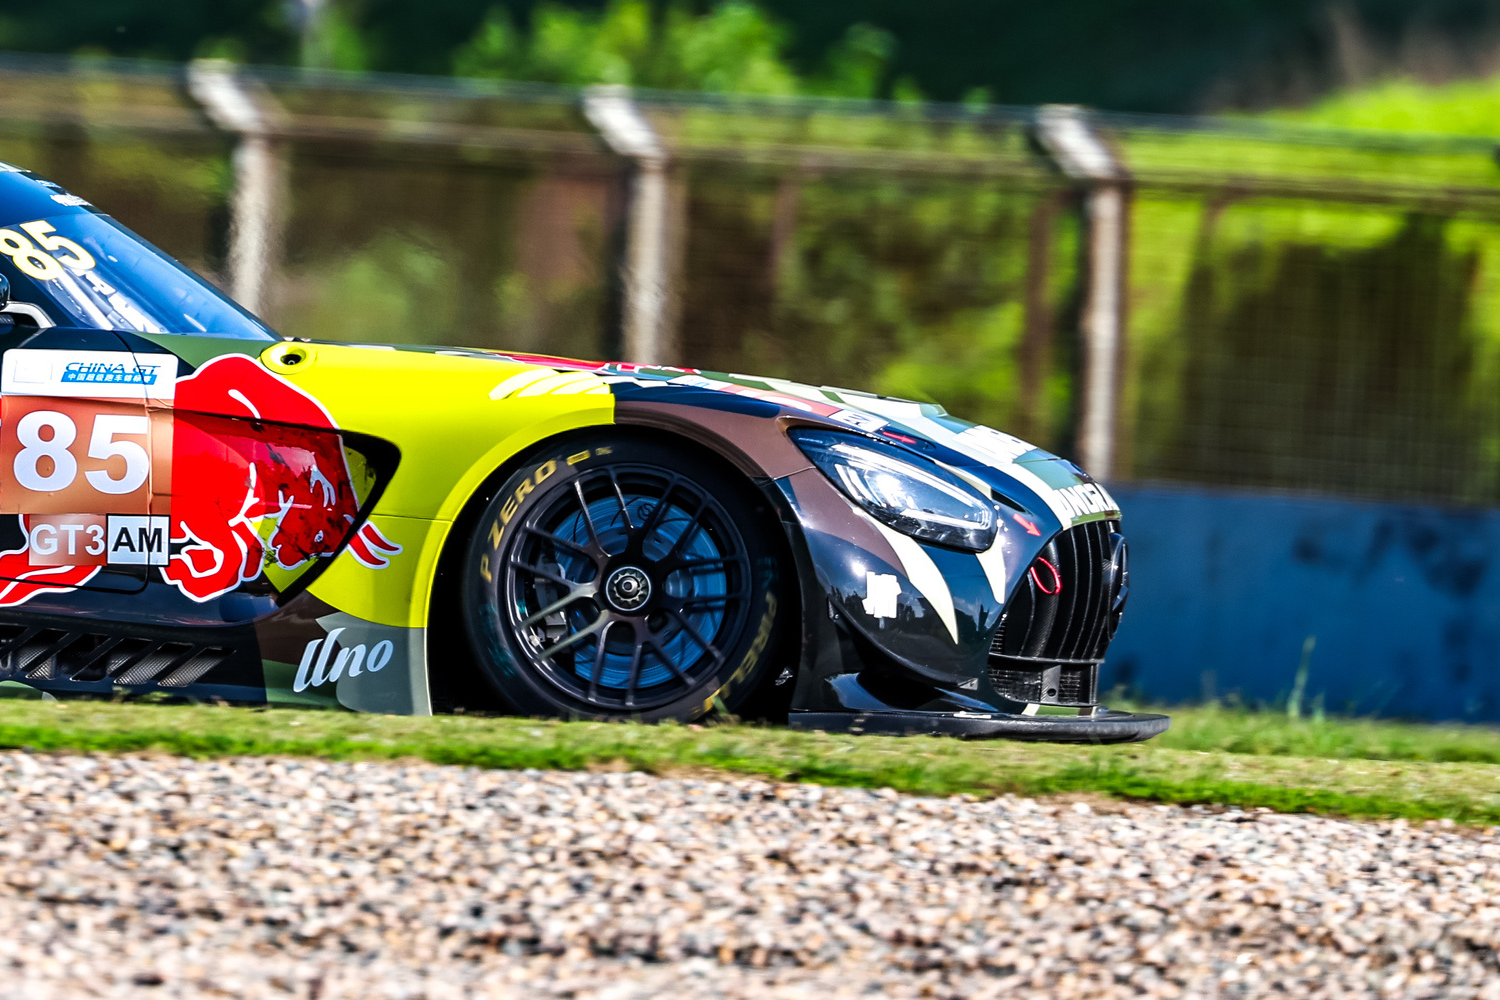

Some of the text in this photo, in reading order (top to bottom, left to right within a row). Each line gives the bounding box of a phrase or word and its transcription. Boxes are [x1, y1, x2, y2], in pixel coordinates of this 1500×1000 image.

[65, 362, 125, 374] CHINA
[13, 410, 150, 495] 85
[29, 523, 163, 556] GT3 AM
[479, 554, 493, 583] P
[487, 459, 558, 551] ZERO
